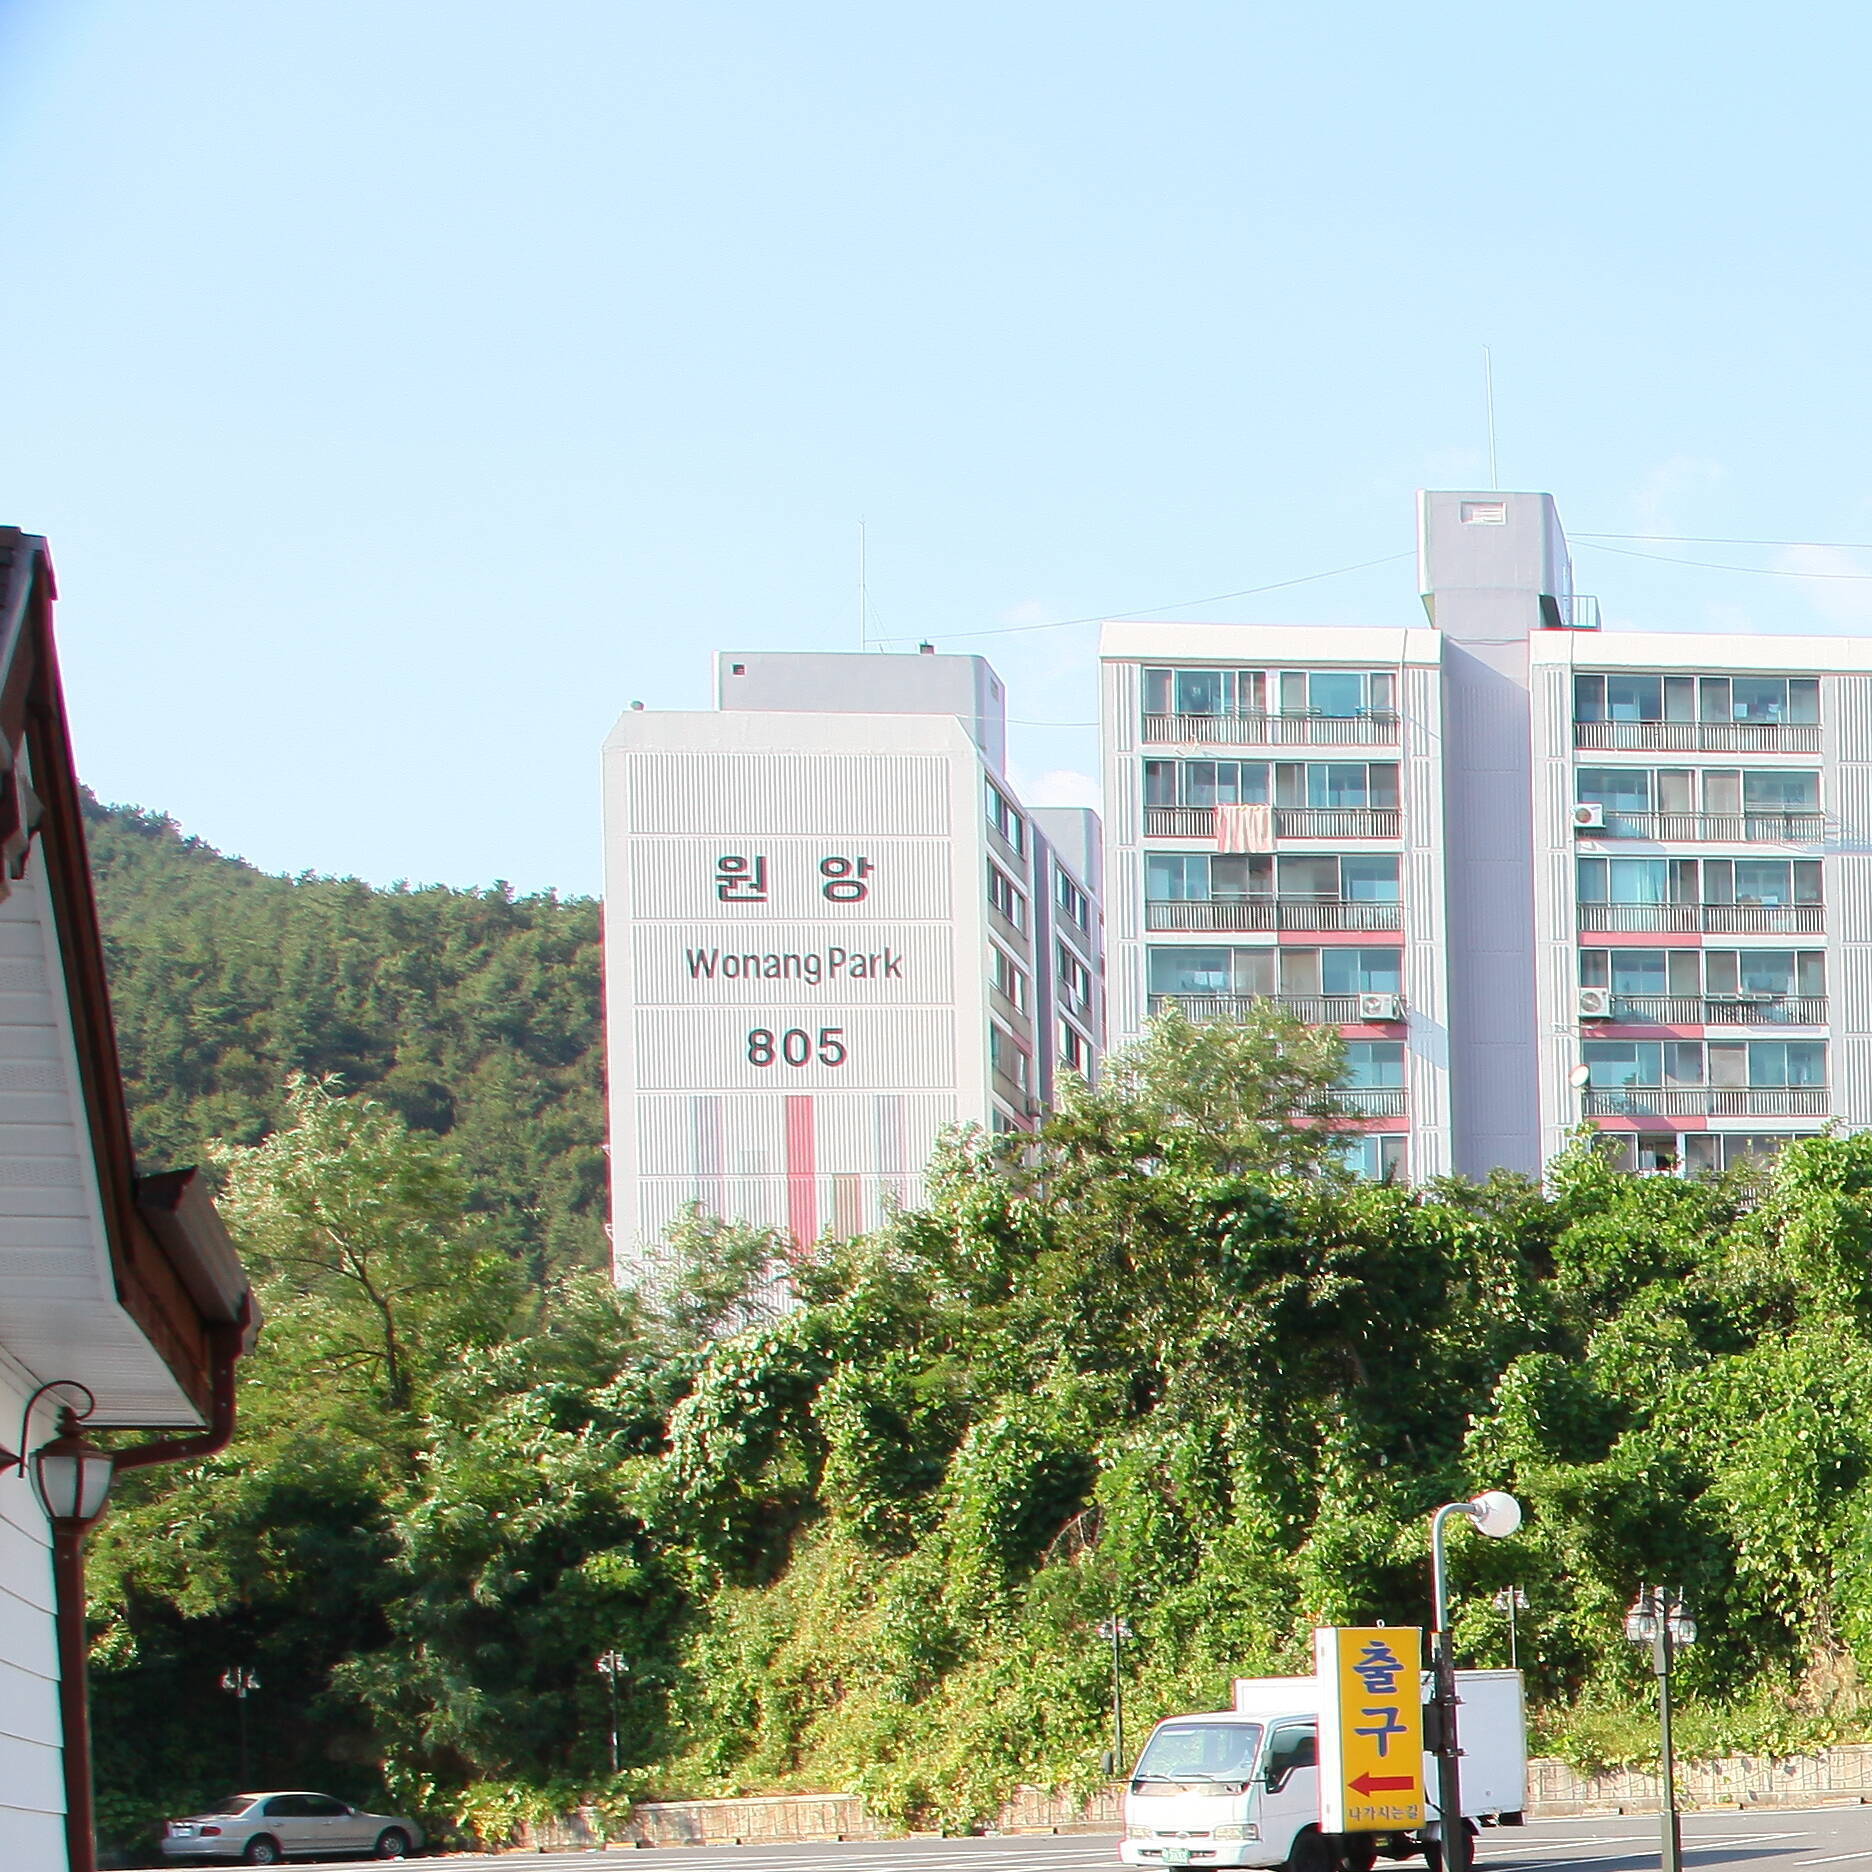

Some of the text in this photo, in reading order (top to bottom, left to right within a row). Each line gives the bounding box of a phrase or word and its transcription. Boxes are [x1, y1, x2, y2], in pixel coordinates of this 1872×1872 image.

[686, 946, 902, 985] Wonang Park
[748, 1028, 847, 1067] 805
[1353, 1640, 1408, 1757] 출구
